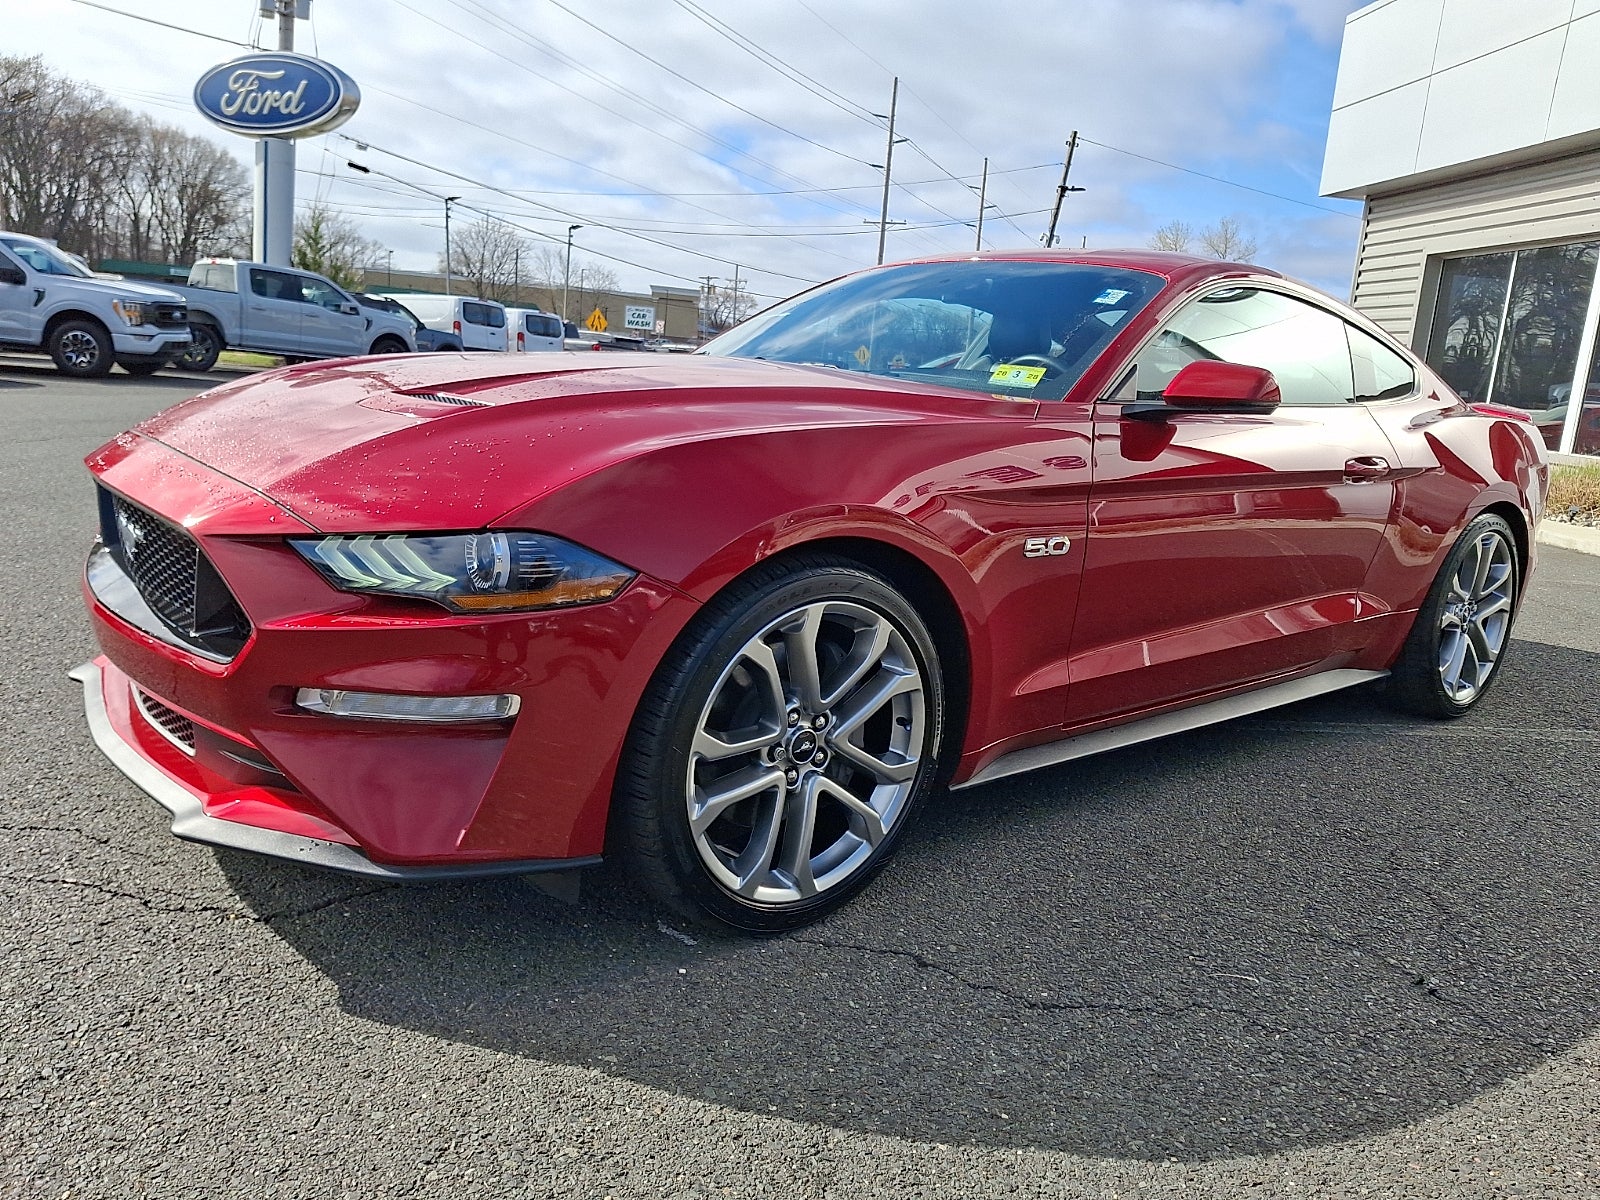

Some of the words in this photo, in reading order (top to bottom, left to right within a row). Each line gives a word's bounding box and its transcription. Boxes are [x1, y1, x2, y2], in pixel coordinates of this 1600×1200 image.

[220, 69, 308, 115] Ford
[627, 319, 651, 327] WASH
[1012, 370, 1021, 379] 3
[1024, 536, 1071, 558] 5.0
